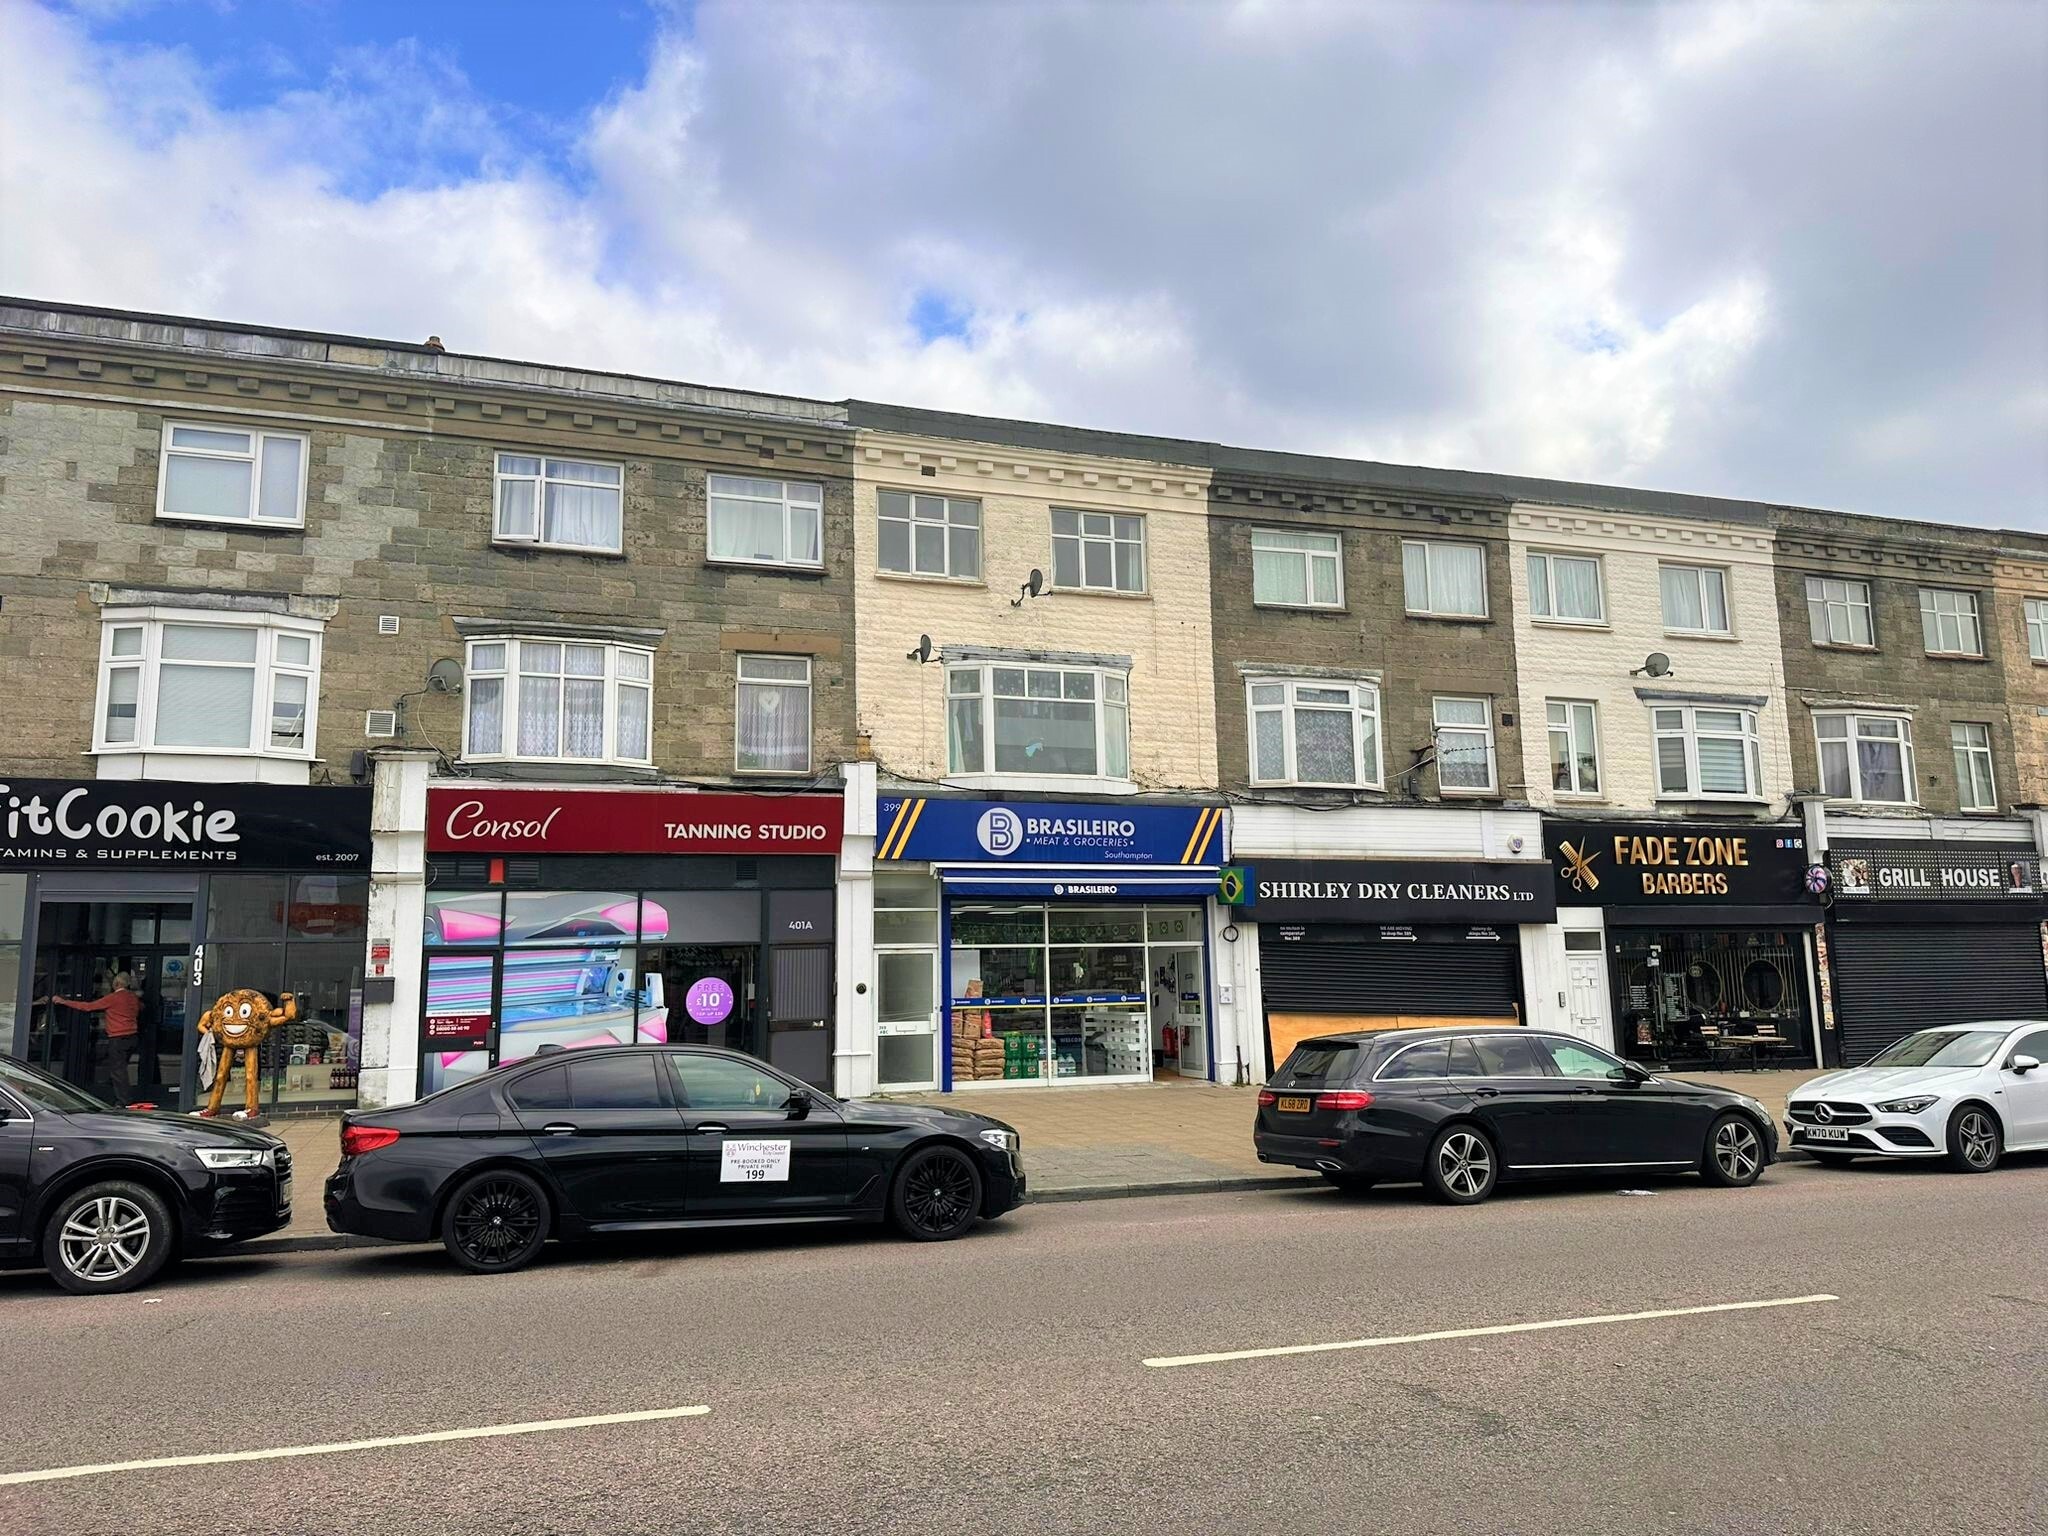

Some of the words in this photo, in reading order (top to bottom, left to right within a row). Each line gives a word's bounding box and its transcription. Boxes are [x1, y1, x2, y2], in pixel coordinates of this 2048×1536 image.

[883, 803, 901, 812] 399
[446, 801, 562, 840] Consol
[664, 823, 752, 839] TANNING
[758, 824, 827, 840] STUDIO
[1027, 818, 1135, 837] BRASILEIRO
[1033, 836, 1060, 846] MEAT
[1063, 836, 1070, 846] &
[1073, 837, 1128, 847] GROCERIES
[75, 849, 88, 858] &
[97, 849, 237, 860] SUPPLEMENTS
[1104, 850, 1153, 860] Southampton
[1614, 836, 1680, 865] FADE
[1683, 836, 1749, 866] ZONE
[335, 853, 359, 861] 2007
[1879, 867, 1931, 887] GRILL
[1941, 868, 2000, 887] HOUSE
[1642, 872, 1729, 895] BARBERS
[1067, 885, 1118, 894] BRASILEIRO
[1259, 881, 1352, 899] SHIRLEY
[1357, 883, 1401, 899] DRY
[1407, 883, 1510, 901] CLEANERS
[1513, 892, 1534, 901] LTD
[788, 921, 813, 930] 401A
[738, 1143, 787, 1151] Winchester
[746, 1170, 765, 1180] 199
